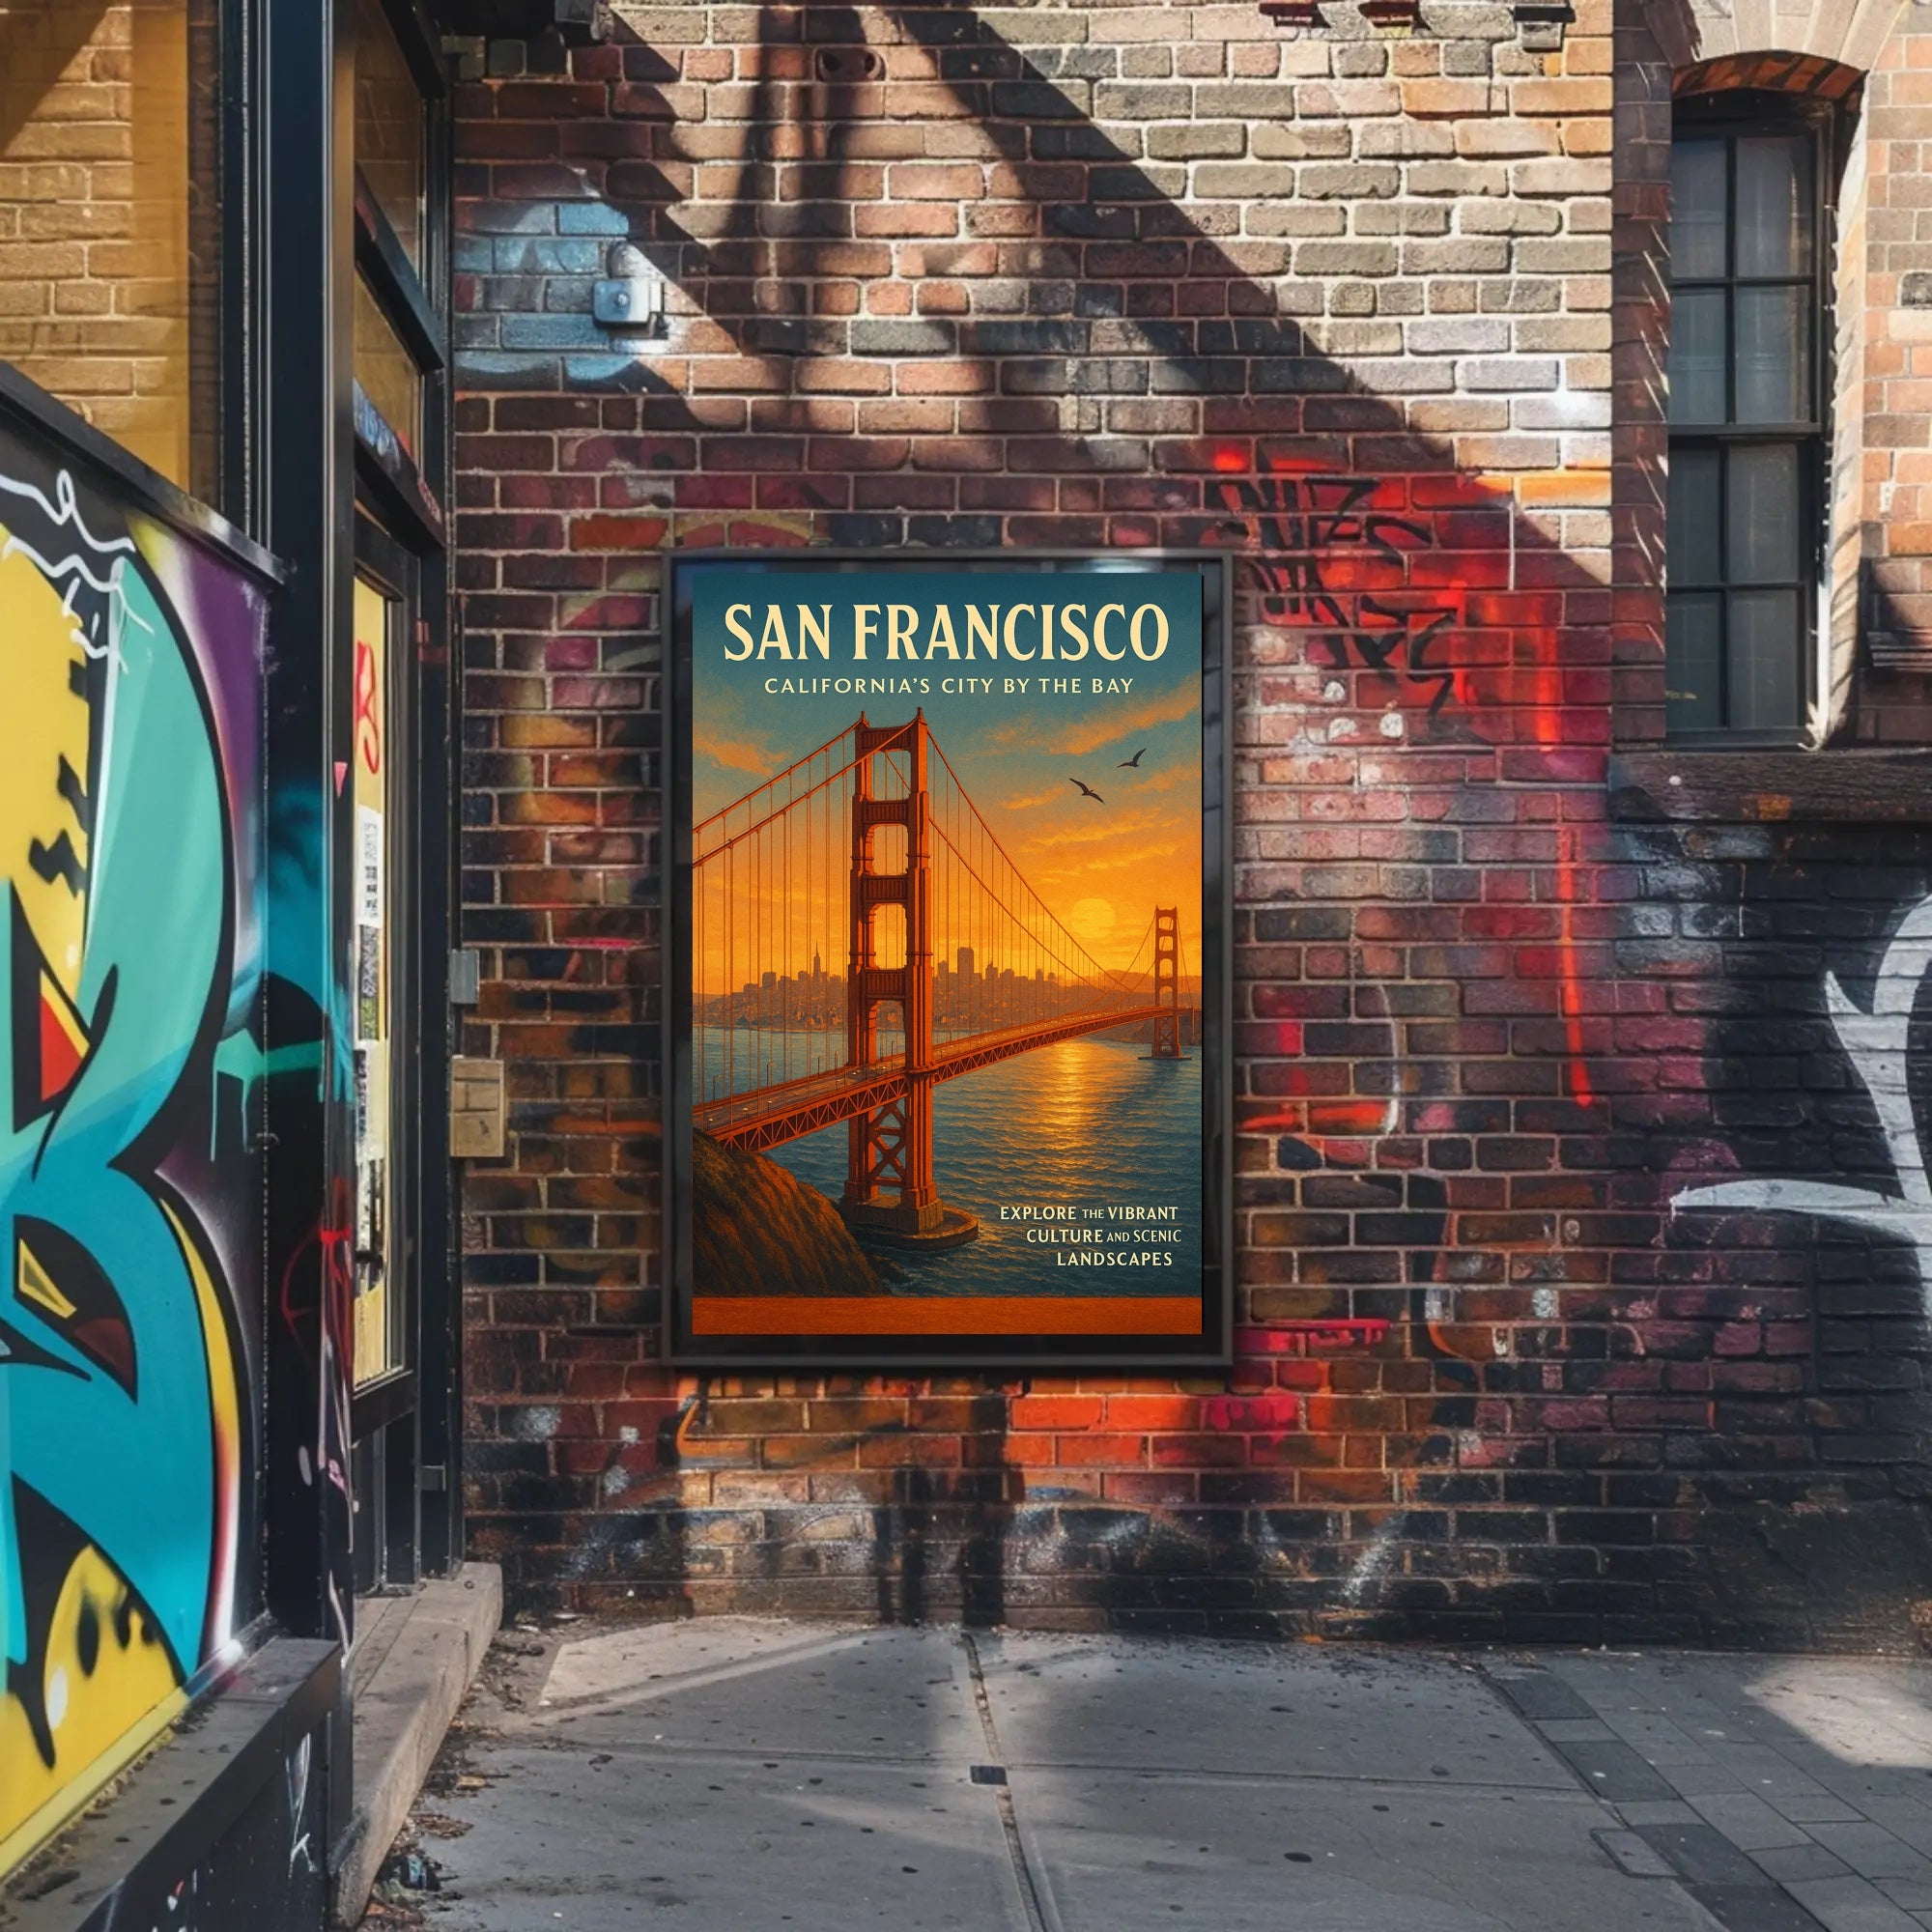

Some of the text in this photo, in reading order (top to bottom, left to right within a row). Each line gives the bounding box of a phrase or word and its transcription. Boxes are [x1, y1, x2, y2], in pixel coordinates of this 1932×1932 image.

[724, 603, 1170, 662] SAN FRANCISCO
[764, 677, 1133, 694] CALIFORNIA'S CITY BY THE BAY
[1000, 1206, 1179, 1220] EXPLORE THE VIBRANT
[1026, 1229, 1181, 1243] CULTURE AND SCENIC
[1057, 1252, 1173, 1266] LANDSCAPES
